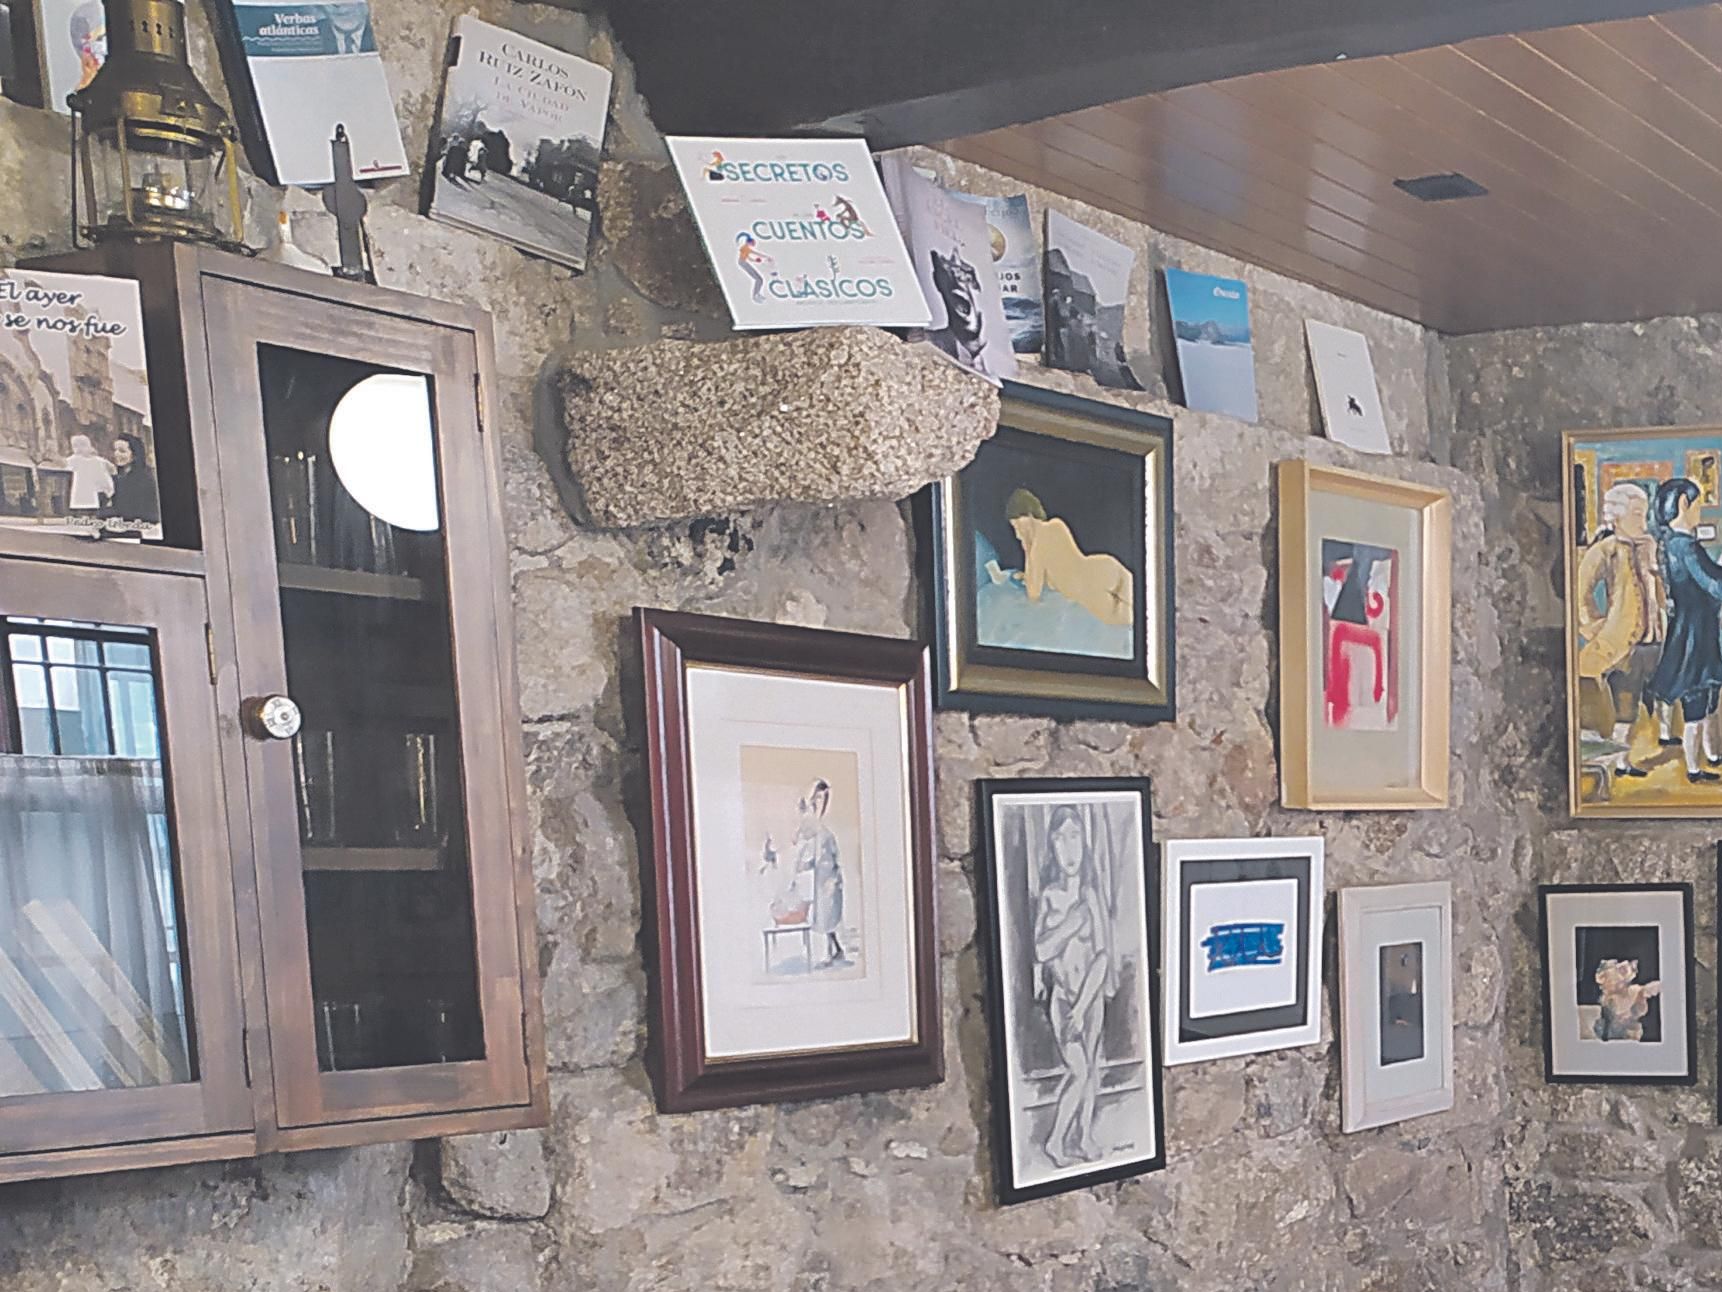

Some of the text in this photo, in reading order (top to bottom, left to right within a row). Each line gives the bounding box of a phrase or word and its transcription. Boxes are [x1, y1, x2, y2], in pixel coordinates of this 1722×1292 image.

[274, 13, 316, 24] Verbas
[259, 24, 320, 36] atlánticas
[479, 51, 523, 79] RUIZ
[502, 43, 569, 79] CARLOS
[722, 162, 849, 183] SECRETOS
[751, 220, 866, 241] CUENTOS
[25, 289, 82, 308] ayer
[5, 313, 128, 336] se nos fue
